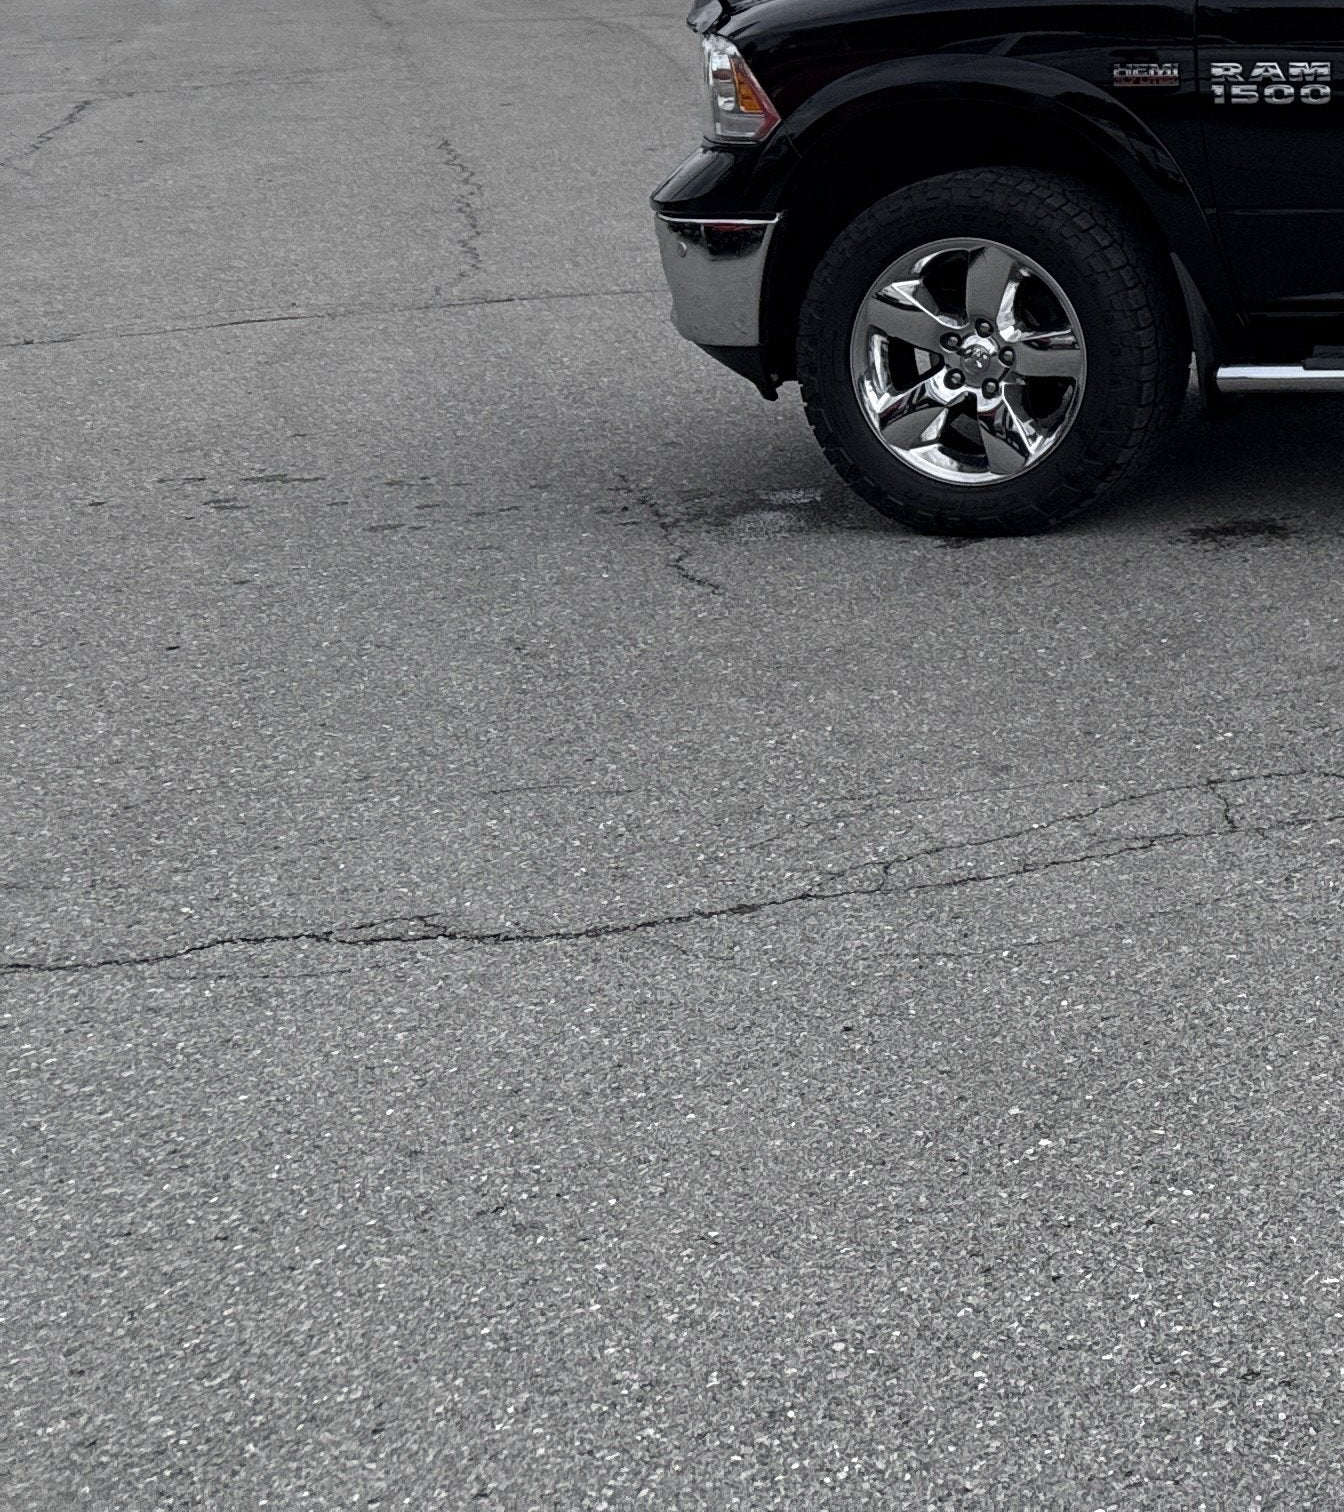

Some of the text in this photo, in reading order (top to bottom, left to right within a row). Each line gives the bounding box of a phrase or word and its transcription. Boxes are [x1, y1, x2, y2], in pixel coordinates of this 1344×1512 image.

[1113, 63, 1178, 76] HEMI
[1210, 61, 1331, 82] RAM
[1210, 84, 1331, 104] 1500
